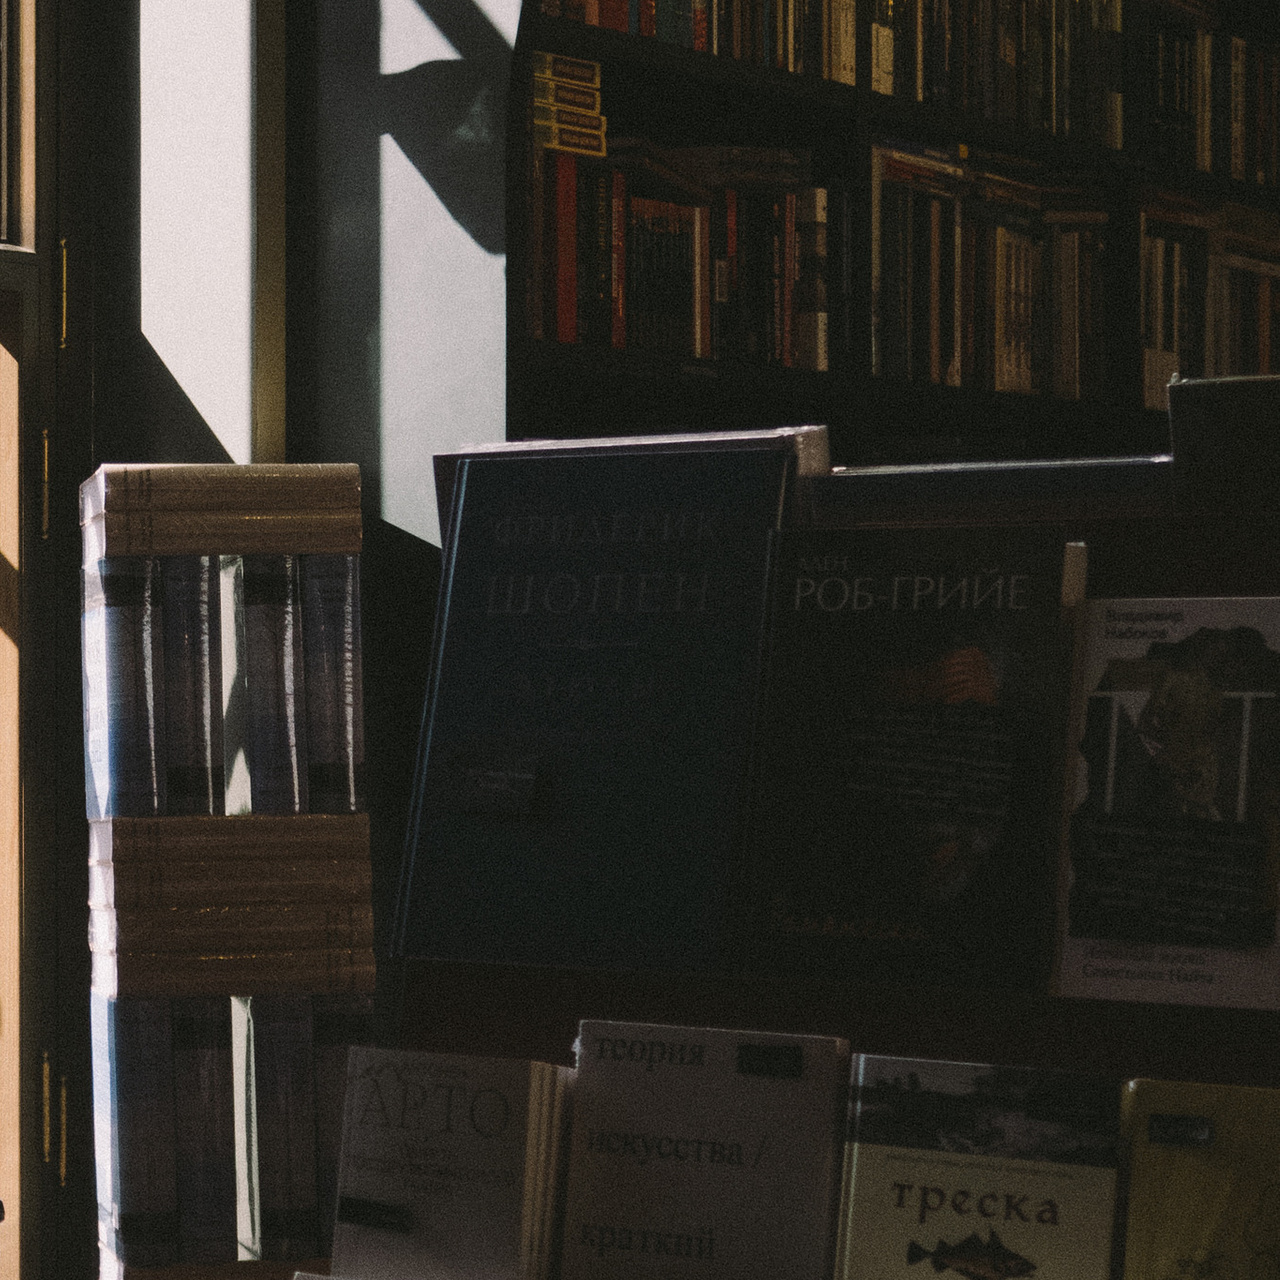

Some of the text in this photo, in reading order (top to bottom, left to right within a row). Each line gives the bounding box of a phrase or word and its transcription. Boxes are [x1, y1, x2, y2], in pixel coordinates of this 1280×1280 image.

[487, 572, 713, 616] ШОПЕН
[794, 567, 1030, 612] РОБ-ГРИЙЕ
[1104, 626, 1167, 641] Набоков
[593, 1031, 708, 1070] теория
[358, 1076, 512, 1139] АРТО
[586, 1126, 745, 1169] искусства
[890, 1180, 1061, 1227] треска
[580, 1221, 717, 1260] краткий
